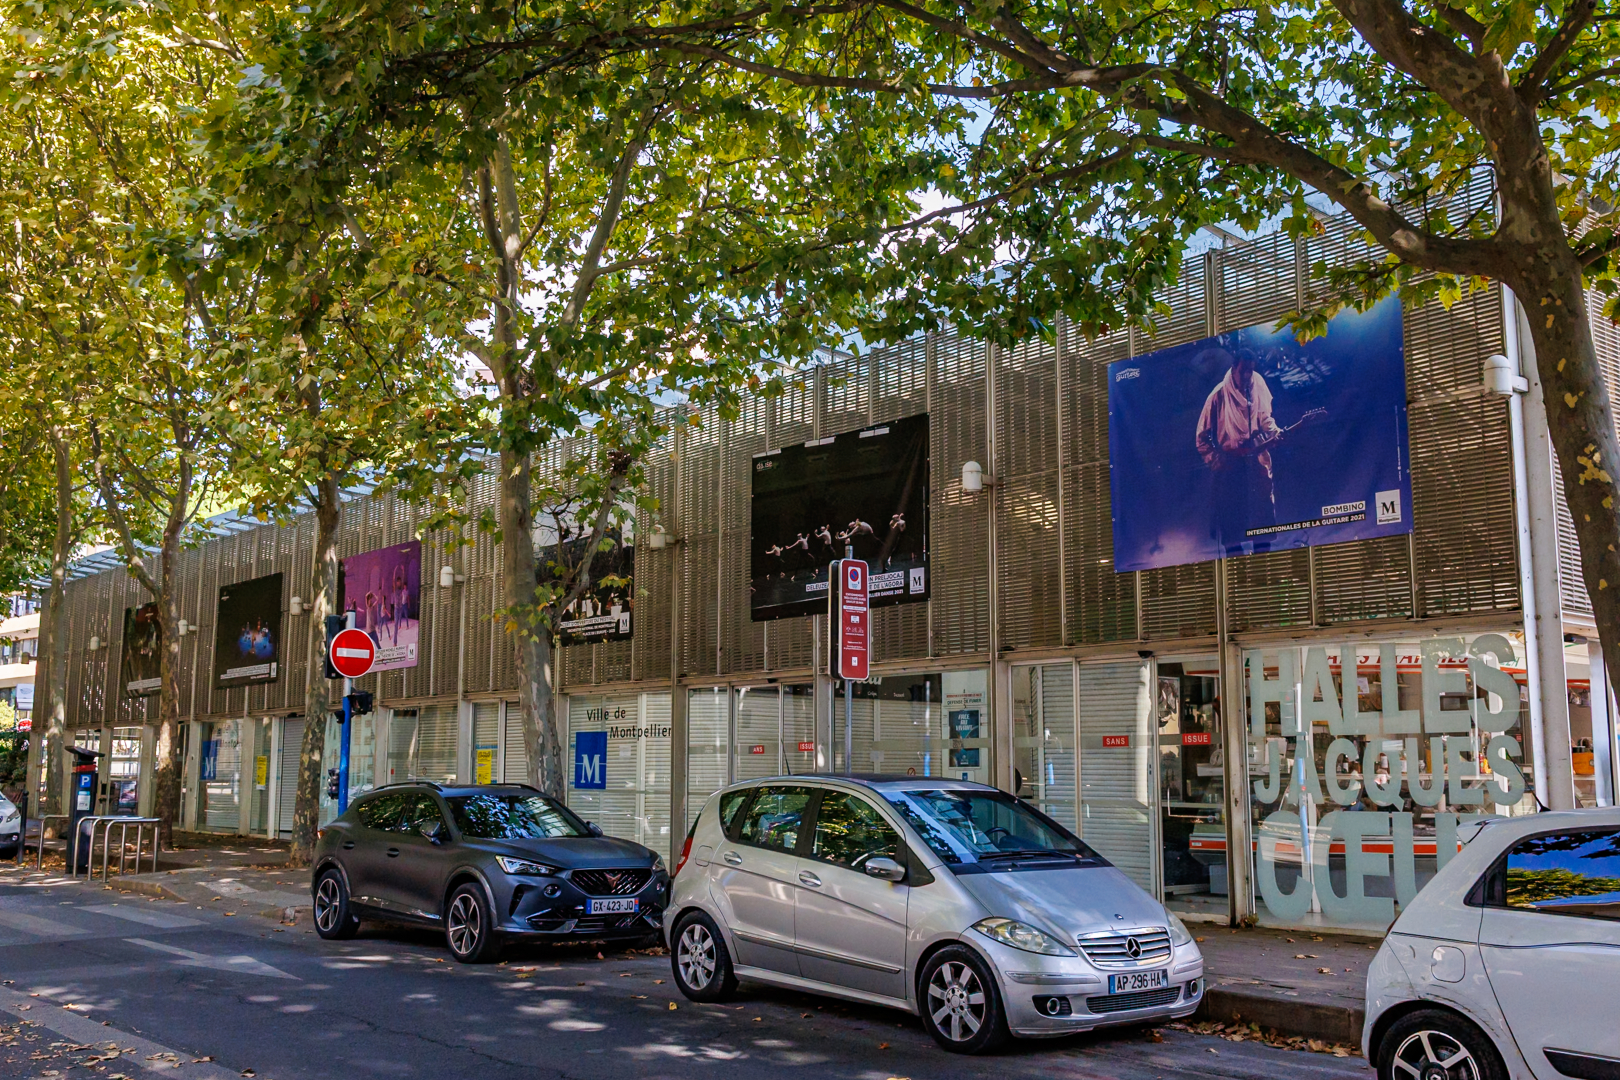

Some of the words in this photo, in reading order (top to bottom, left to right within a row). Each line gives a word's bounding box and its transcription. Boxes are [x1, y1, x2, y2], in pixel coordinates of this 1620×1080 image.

[1323, 503, 1364, 514] BOMBINO
[1381, 501, 1396, 516] M
[1246, 523, 1301, 536] INTERNATIONALES
[1321, 516, 1350, 526] GUITARE
[1350, 513, 1365, 521] 2021
[874, 571, 904, 580] PRELJOCAJ
[913, 576, 921, 586] M
[1252, 634, 1520, 737] HALLES
[587, 708, 609, 721] Ville
[614, 706, 626, 719] de
[610, 724, 671, 741] Montpellier
[1184, 733, 1208, 743] ISSUE
[1105, 737, 1126, 745] SANS
[580, 754, 601, 783] M
[1254, 735, 1525, 812] JACQUES
[81, 775, 90, 786] P
[1257, 810, 1509, 921] CŒU
[1117, 972, 1162, 991] AP-296-HA
